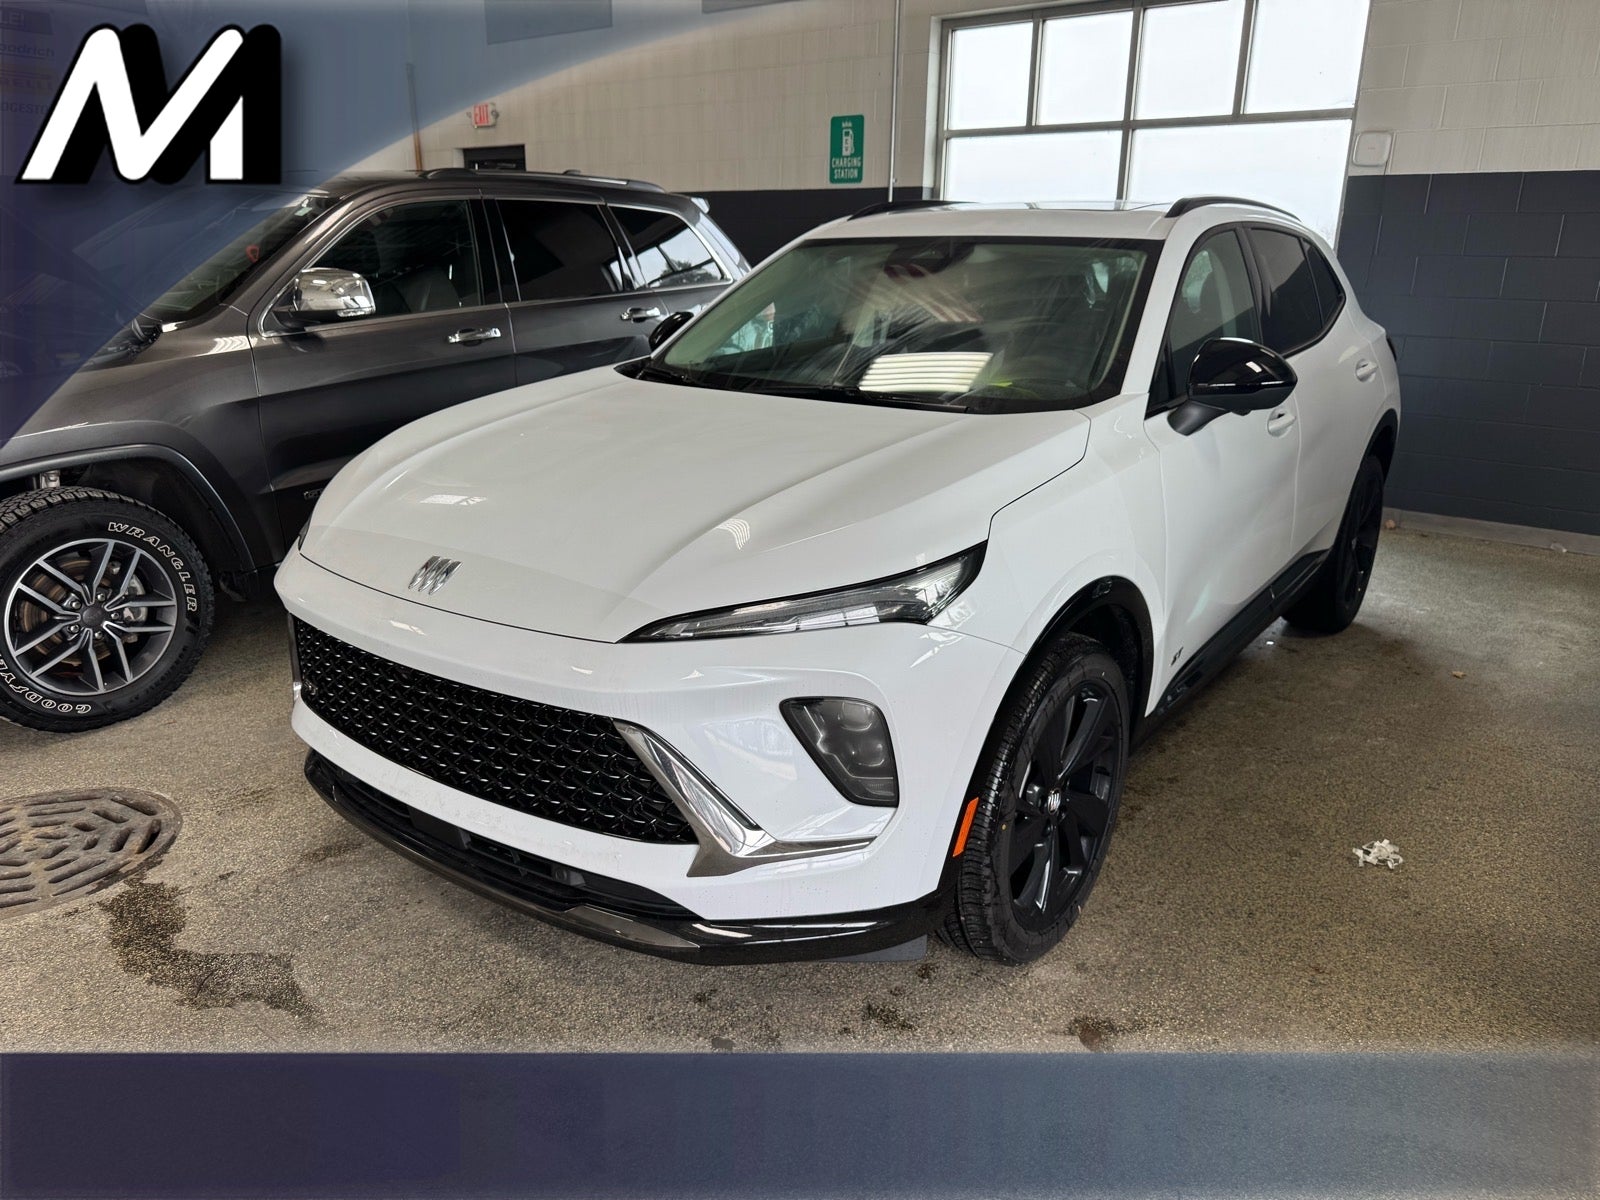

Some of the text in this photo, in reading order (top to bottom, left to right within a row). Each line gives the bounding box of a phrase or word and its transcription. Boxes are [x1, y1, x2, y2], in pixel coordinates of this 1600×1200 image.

[832, 157, 862, 168] CHARGING
[834, 168, 858, 179] STATION
[108, 522, 198, 612] WRANGLER
